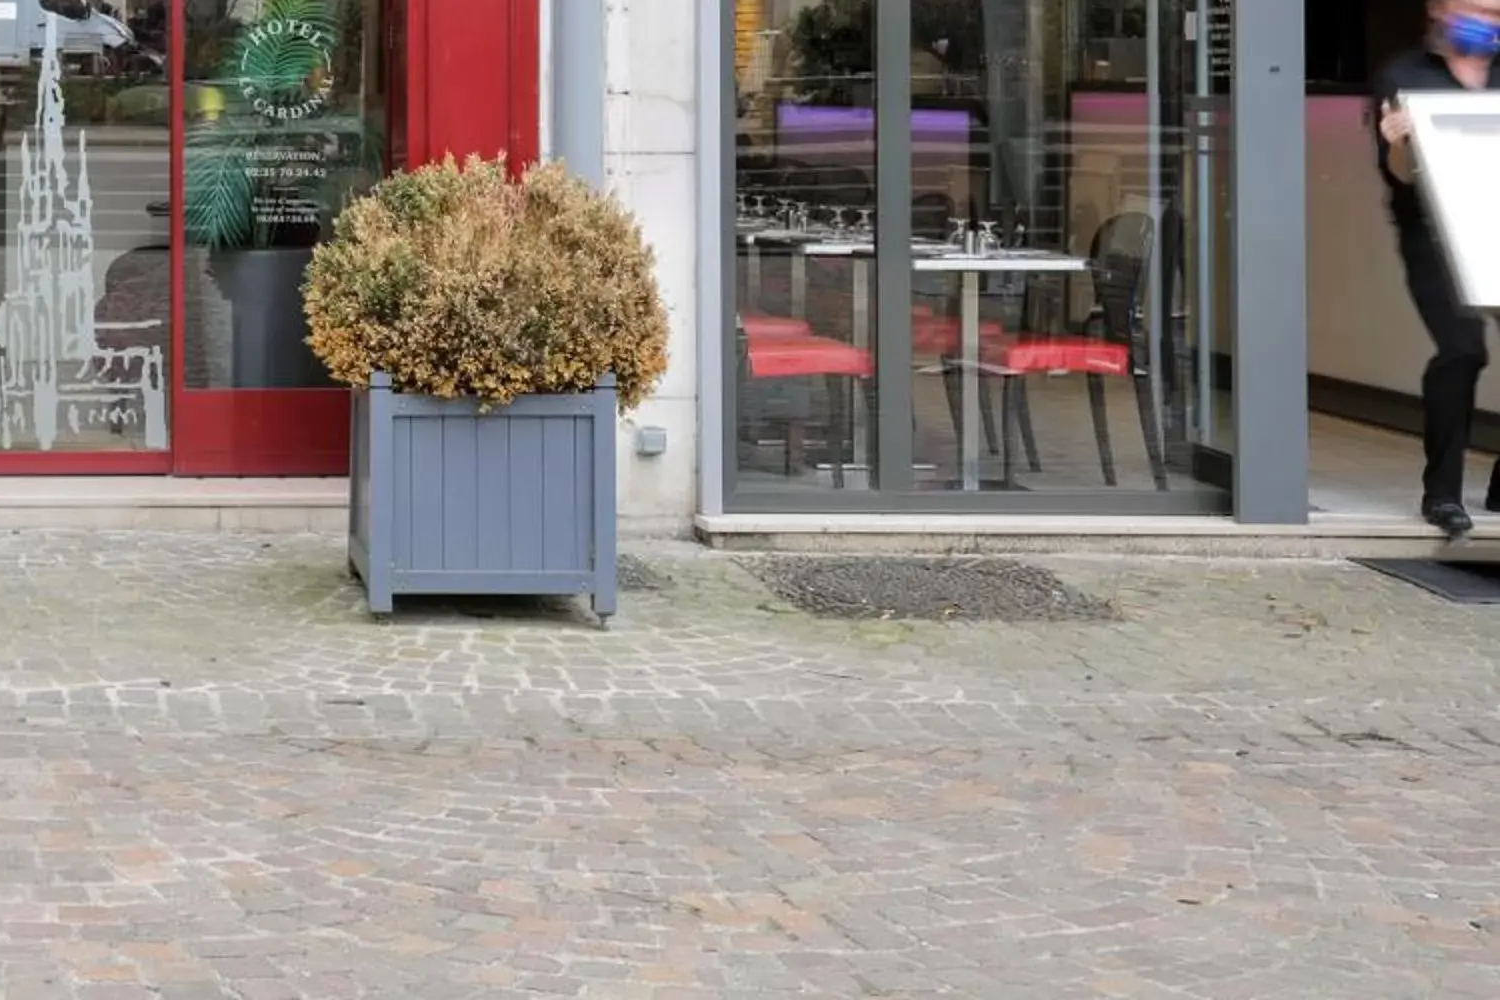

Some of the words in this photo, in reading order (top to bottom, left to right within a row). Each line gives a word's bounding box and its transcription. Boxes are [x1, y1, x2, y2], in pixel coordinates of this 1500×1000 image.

[248, 19, 323, 47] HOTEL
[239, 76, 255, 99] LE
[253, 74, 335, 120] CARDINAL
